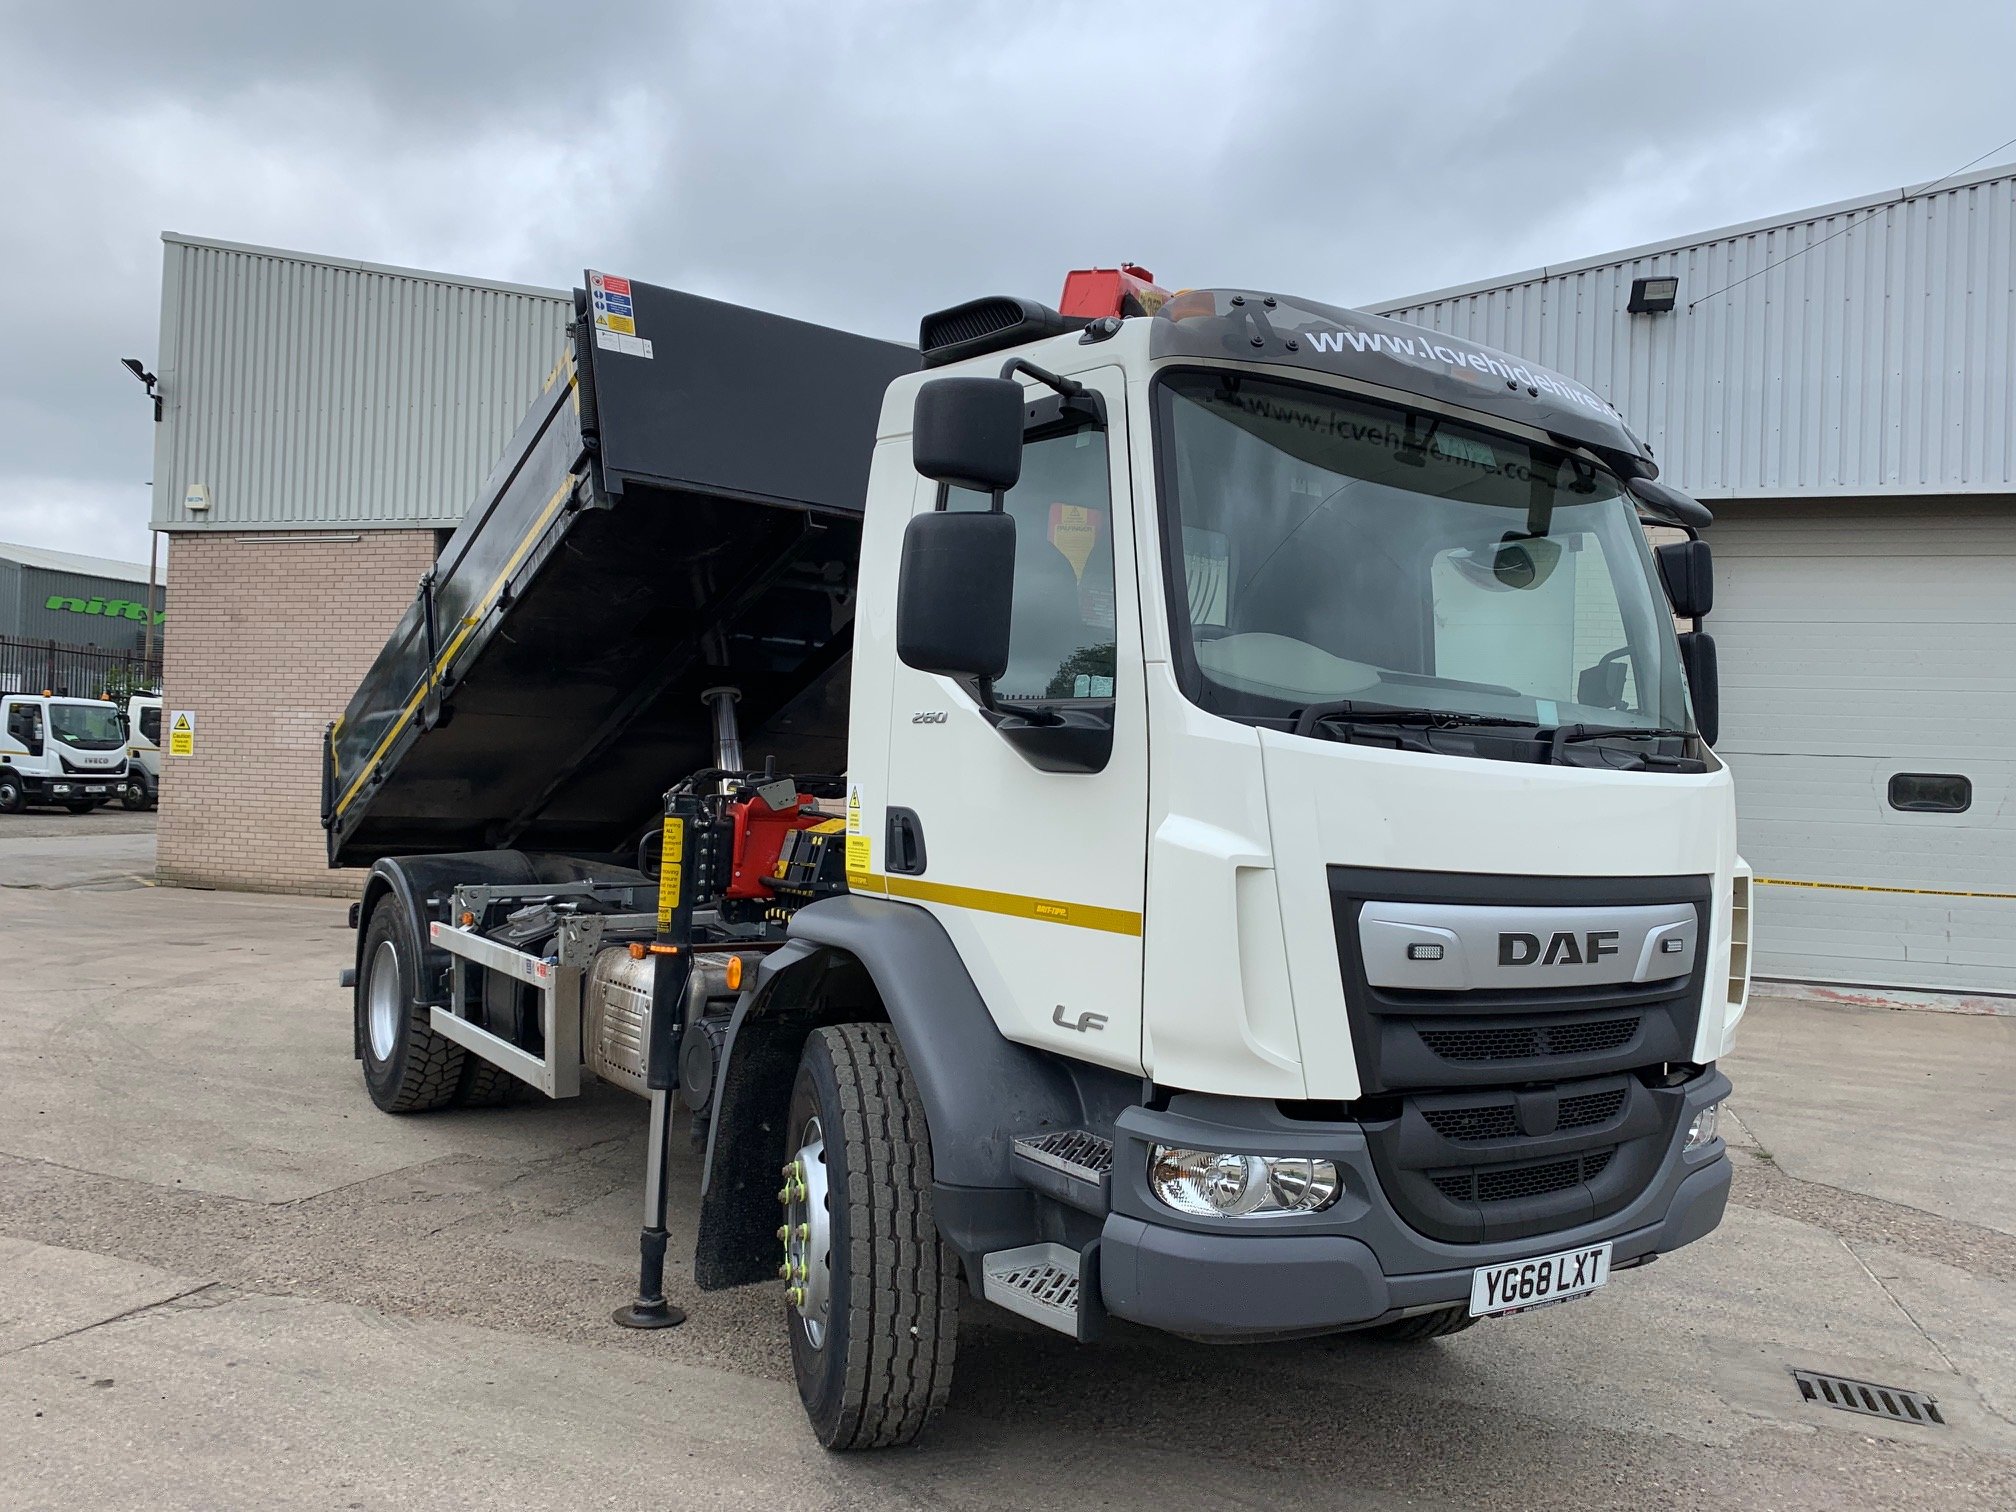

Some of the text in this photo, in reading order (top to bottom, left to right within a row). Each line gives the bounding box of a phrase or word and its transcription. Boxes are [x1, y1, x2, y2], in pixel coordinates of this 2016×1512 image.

[911, 711, 948, 724] 260
[1498, 931, 1619, 967] DAF
[1052, 1005, 1109, 1032] LF
[1486, 1249, 1603, 1306] YG68 LXT
